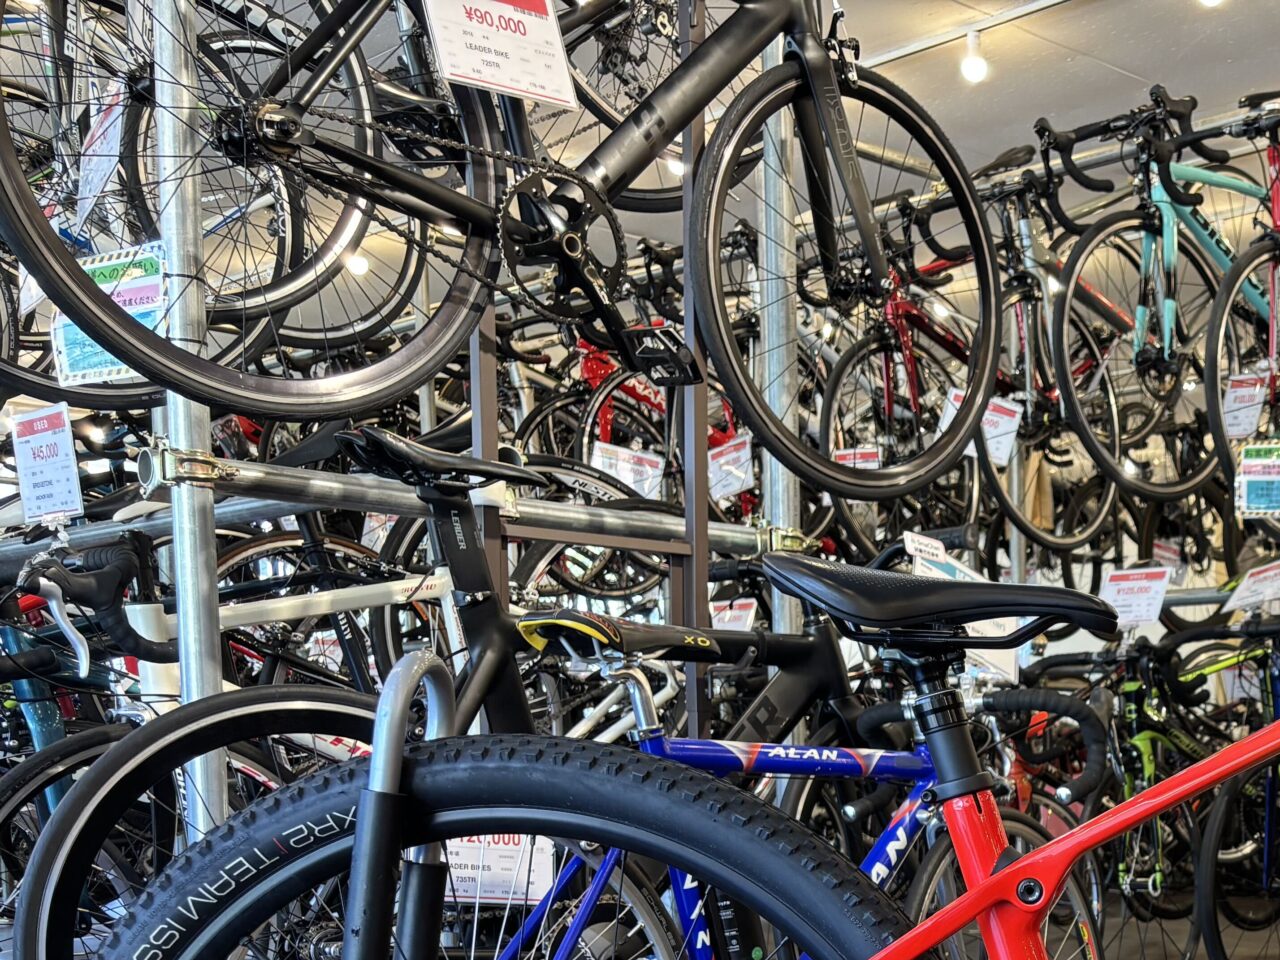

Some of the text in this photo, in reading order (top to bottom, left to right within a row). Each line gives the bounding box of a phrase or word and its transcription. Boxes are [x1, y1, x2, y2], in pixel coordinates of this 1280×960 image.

[463, 4, 527, 36] ¥90,000
[465, 42, 510, 60] LEADER BIKE
[31, 442, 59, 461] ¥45,000
[450, 509, 467, 550] LEADER
[768, 746, 838, 761] ALAN
[282, 805, 358, 848] XR2
[459, 834, 521, 847] 120,000
[449, 861, 469, 871] ADER
[178, 848, 280, 921] TEAM
